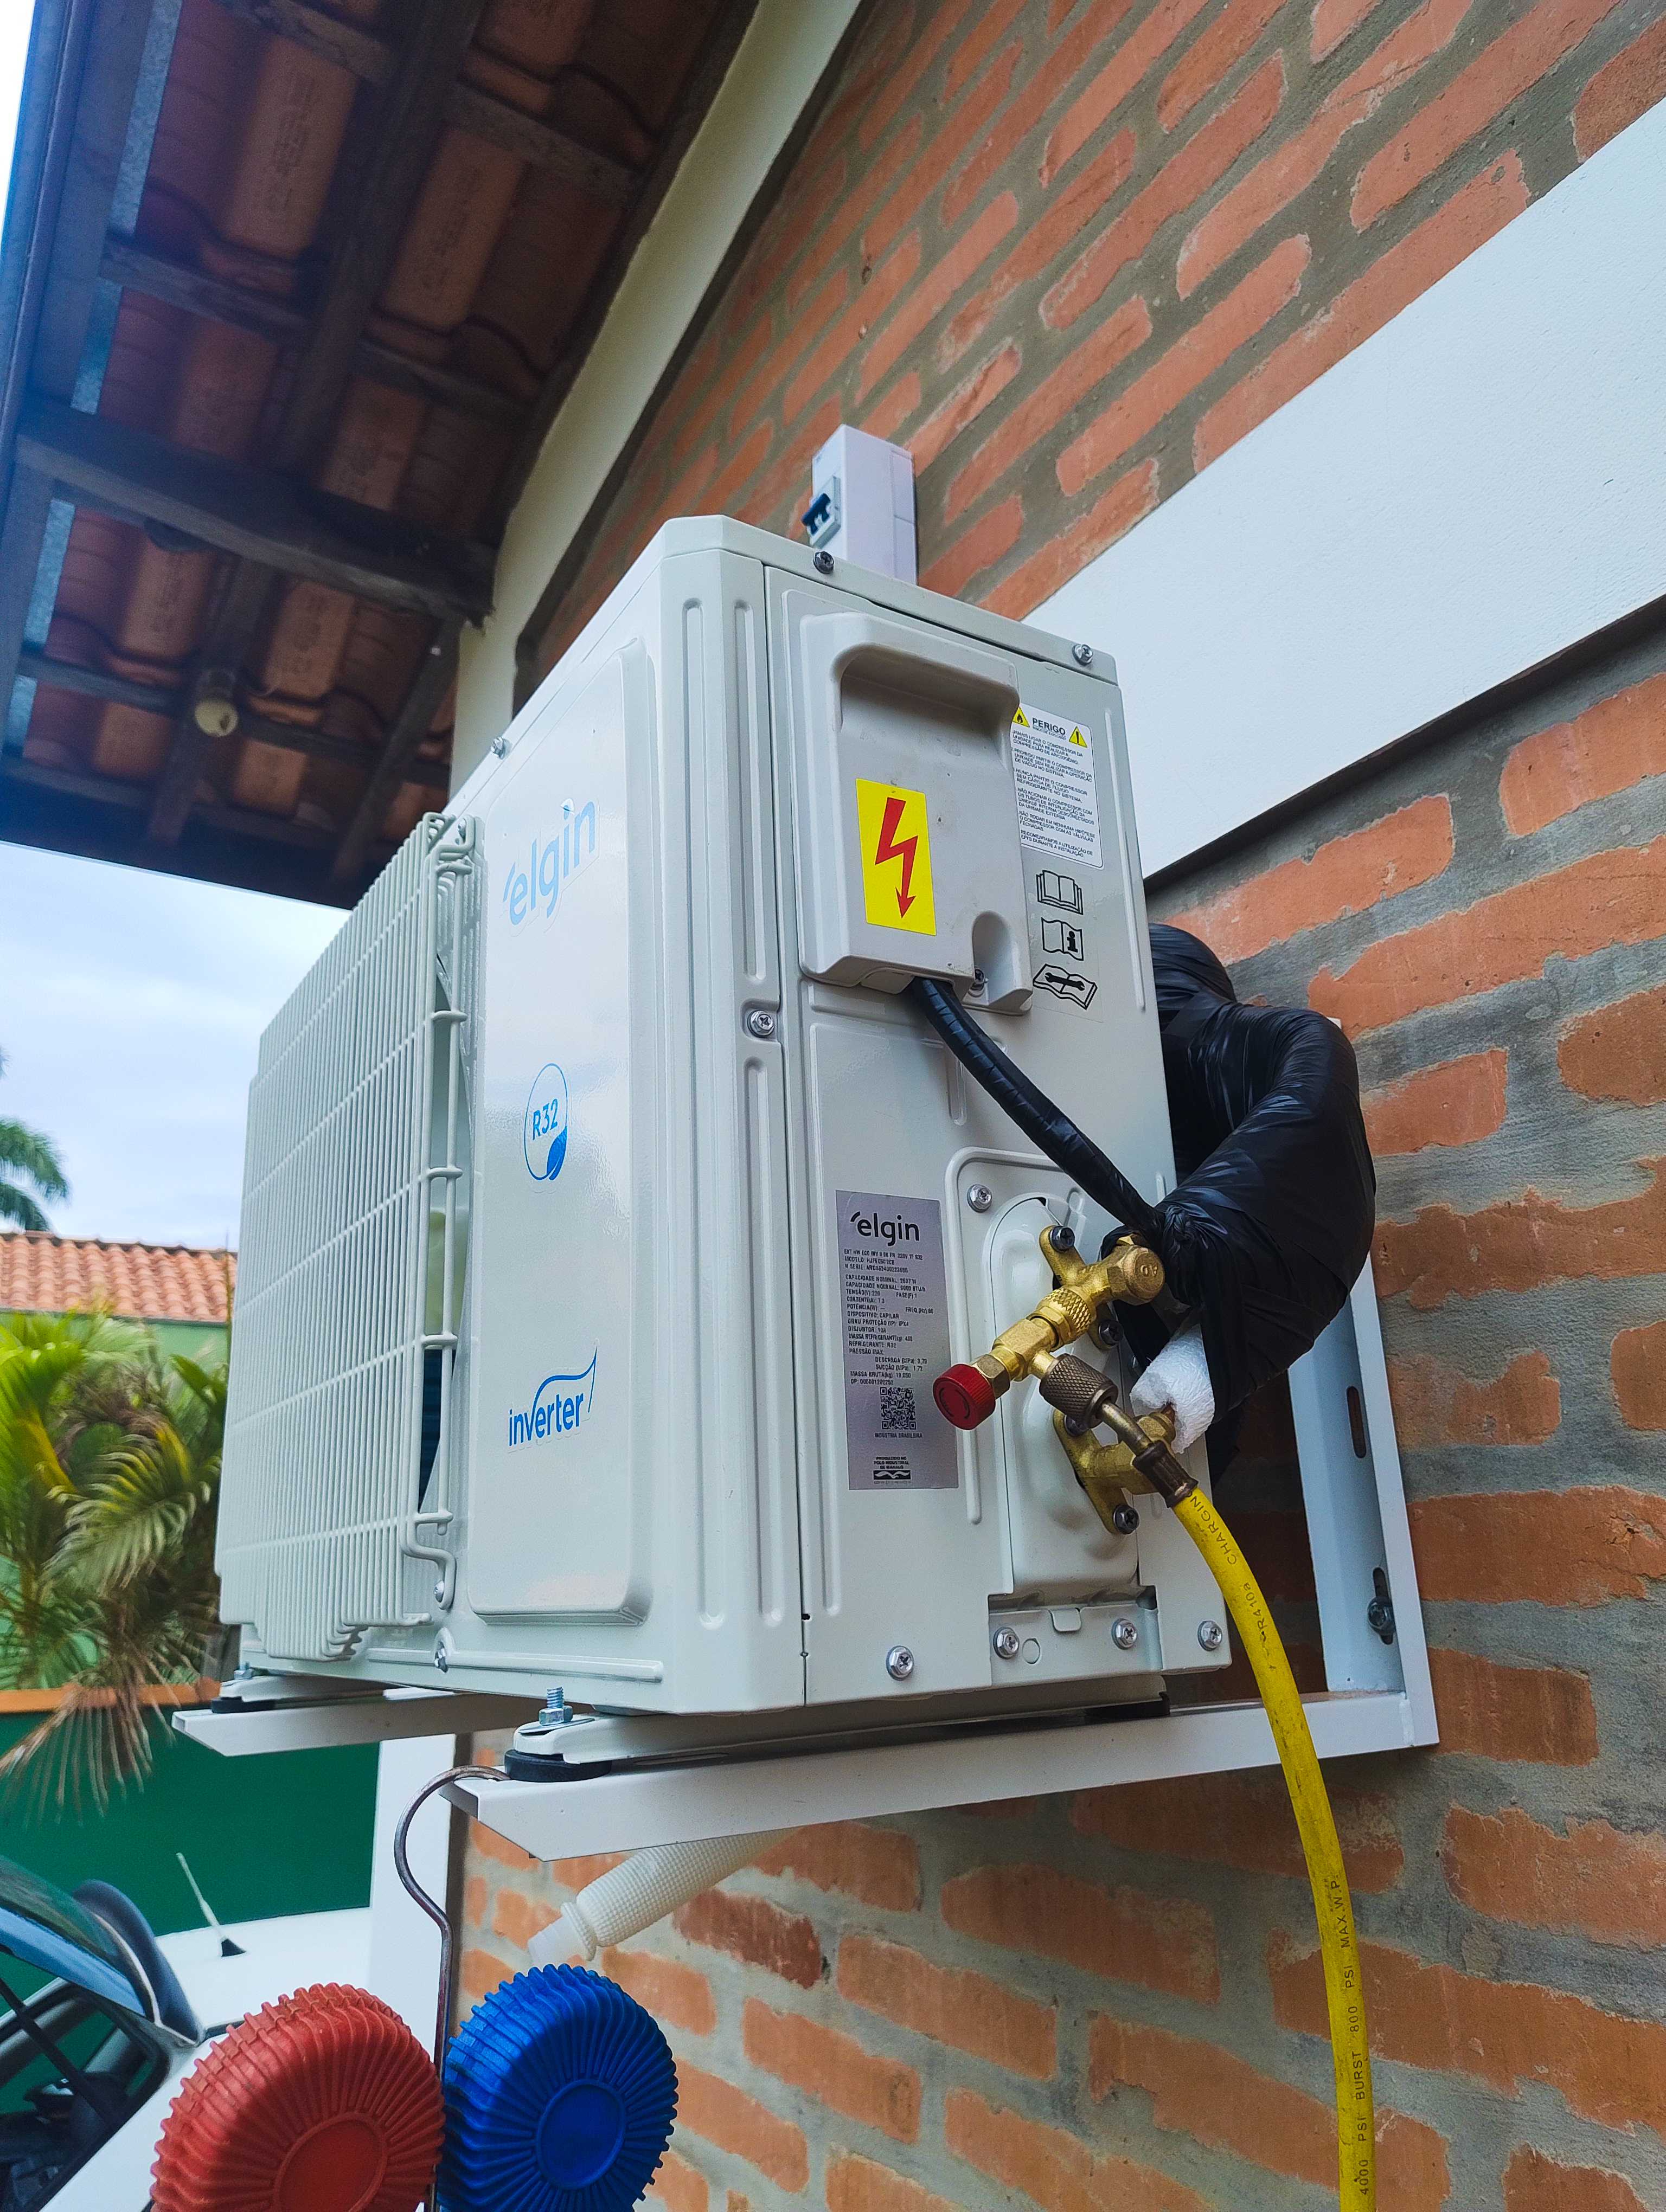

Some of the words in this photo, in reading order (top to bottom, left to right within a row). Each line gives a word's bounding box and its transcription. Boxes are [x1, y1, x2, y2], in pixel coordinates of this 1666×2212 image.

[1032, 717, 1066, 736] PERIGO
[1055, 781, 1087, 796] COMPRESSOR
[533, 1098, 558, 1140] R32
[845, 1274, 874, 1282] CAPACIDADE
[862, 1317, 887, 1327] PROTEÇÃO
[875, 1362, 895, 1372] SUCÇÃO
[509, 1391, 584, 1446] inverter
[1343, 1965, 1355, 1988] PSI
[1348, 2005, 1359, 2033] 800
[1351, 2050, 1366, 2100] BURST
[1357, 2117, 1367, 2142] PSI
[1358, 2159, 1369, 2195] 4000
